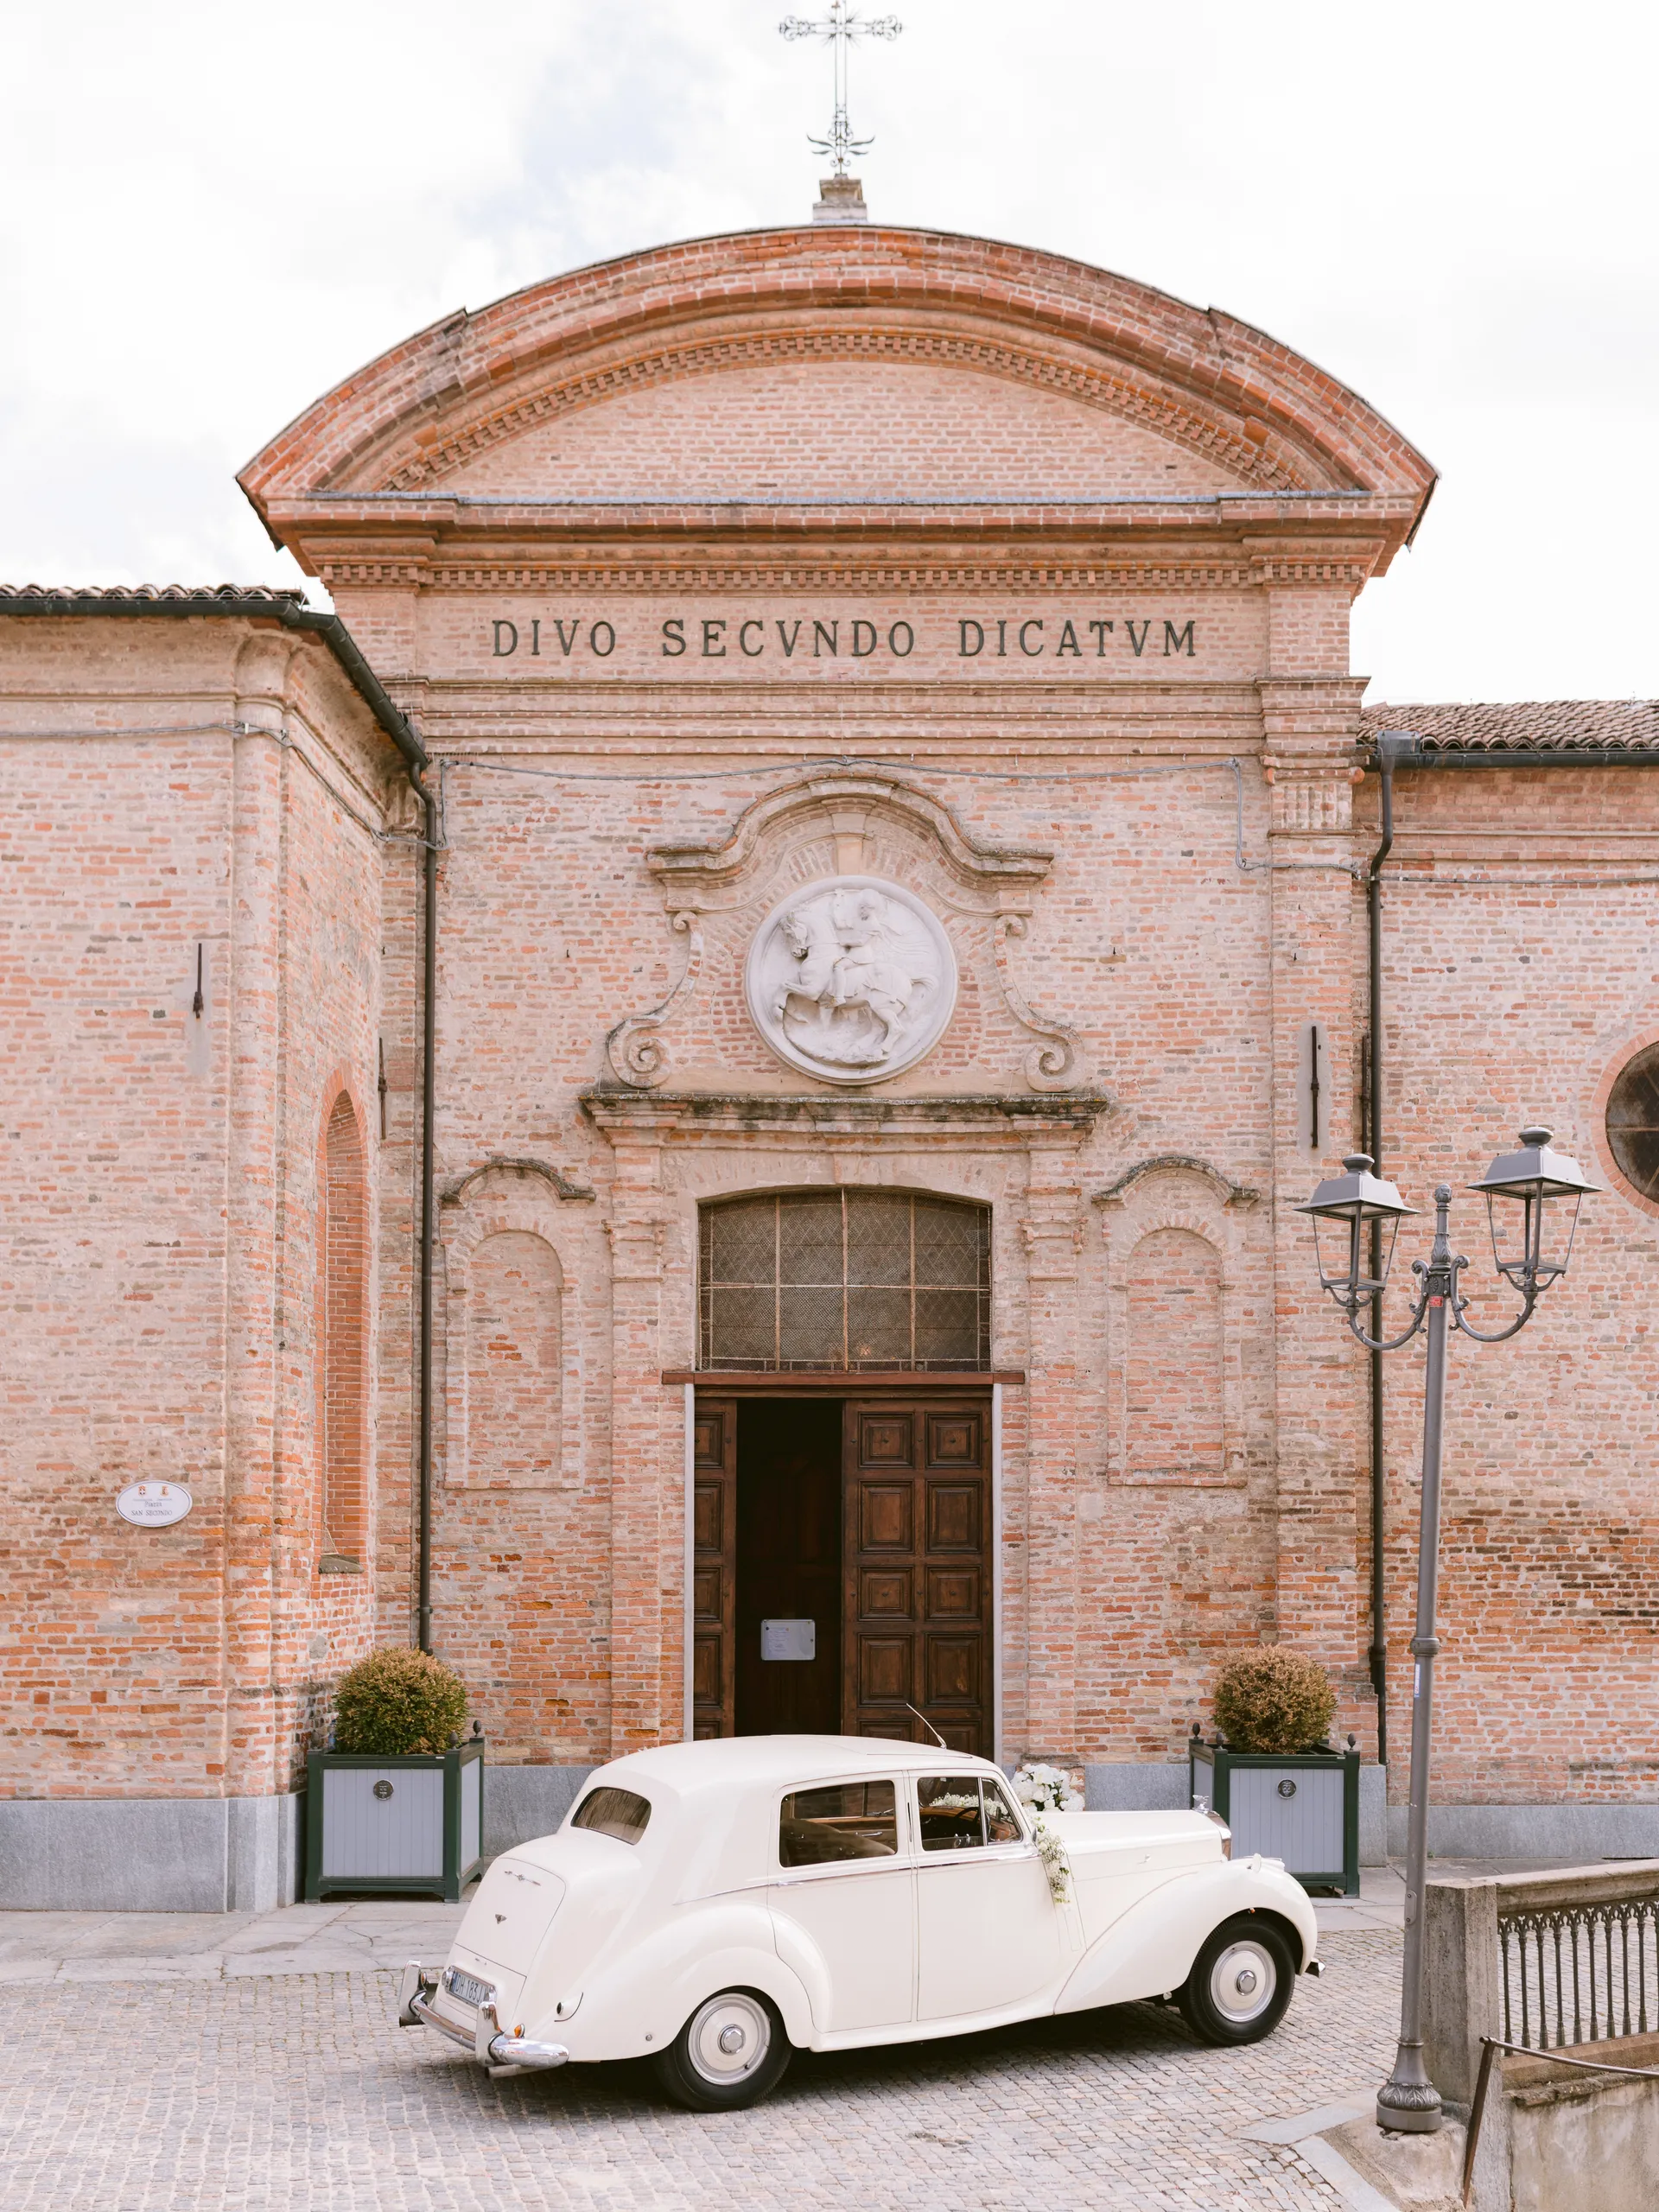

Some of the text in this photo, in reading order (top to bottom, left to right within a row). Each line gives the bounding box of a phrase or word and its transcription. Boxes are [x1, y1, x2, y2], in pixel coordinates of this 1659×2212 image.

[492, 619, 1197, 658] DIVO SECVNDO DICATVM
